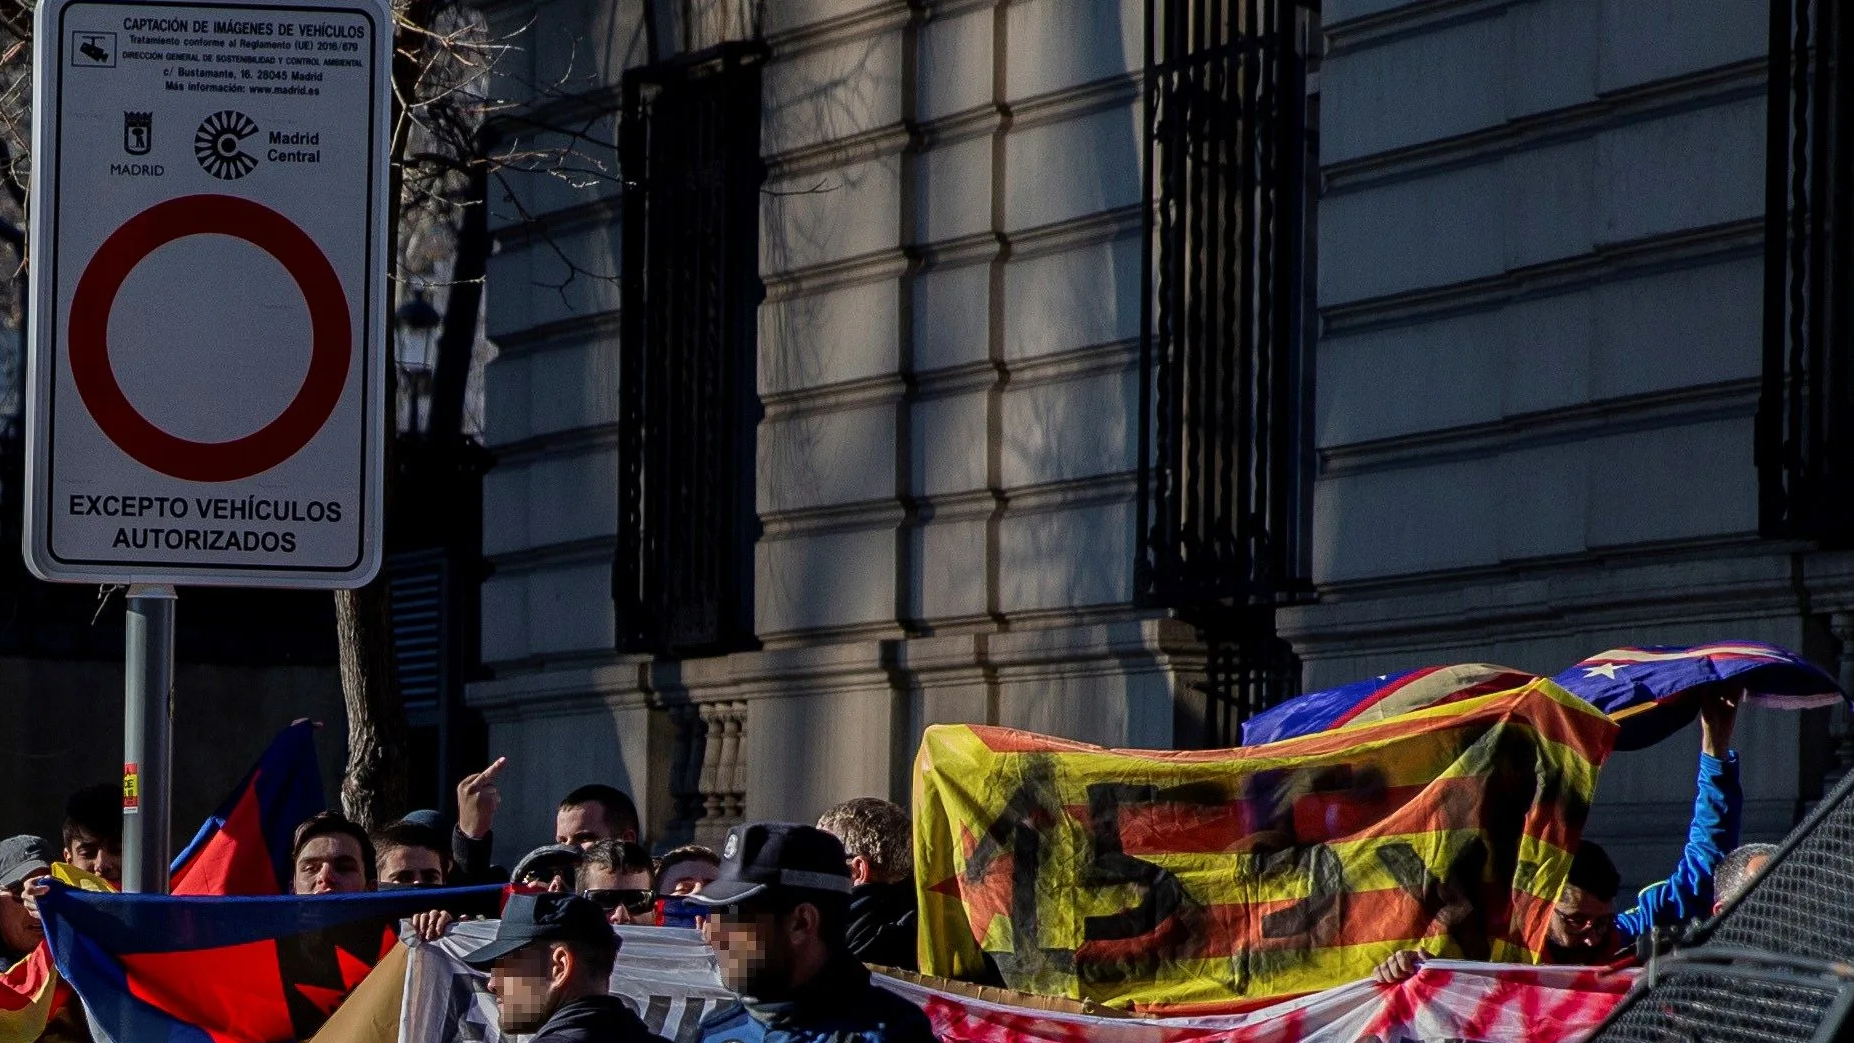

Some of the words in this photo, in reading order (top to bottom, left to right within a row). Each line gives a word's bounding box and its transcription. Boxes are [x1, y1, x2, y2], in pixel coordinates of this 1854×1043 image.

[123, 16, 188, 33] CAPTACIÓN
[193, 20, 209, 34] DE
[213, 18, 274, 36] IMÁGENES
[278, 23, 294, 36] DE
[299, 22, 365, 39] VEHÍCULOS
[129, 34, 180, 46] Tratamiento
[183, 37, 225, 47] conforme
[228, 38, 237, 48] al
[239, 39, 291, 51] Reglamento
[294, 40, 314, 51] (UE)
[165, 52, 200, 61] GENERAL
[202, 54, 213, 62] DE
[277, 56, 283, 65] Y
[285, 57, 320, 66] CONTROL
[163, 66, 174, 77] c/
[257, 69, 288, 80] 28045
[291, 71, 323, 82] Madrid
[165, 80, 185, 91] Más
[248, 85, 320, 96] www.madrid.es
[268, 131, 320, 146] Madrid
[267, 149, 321, 163] Central
[109, 163, 165, 177] MADRID
[69, 495, 189, 518] EXCEPTO
[195, 495, 342, 522] VEHÍCULOS
[112, 527, 297, 552] AUTORIZADOS
